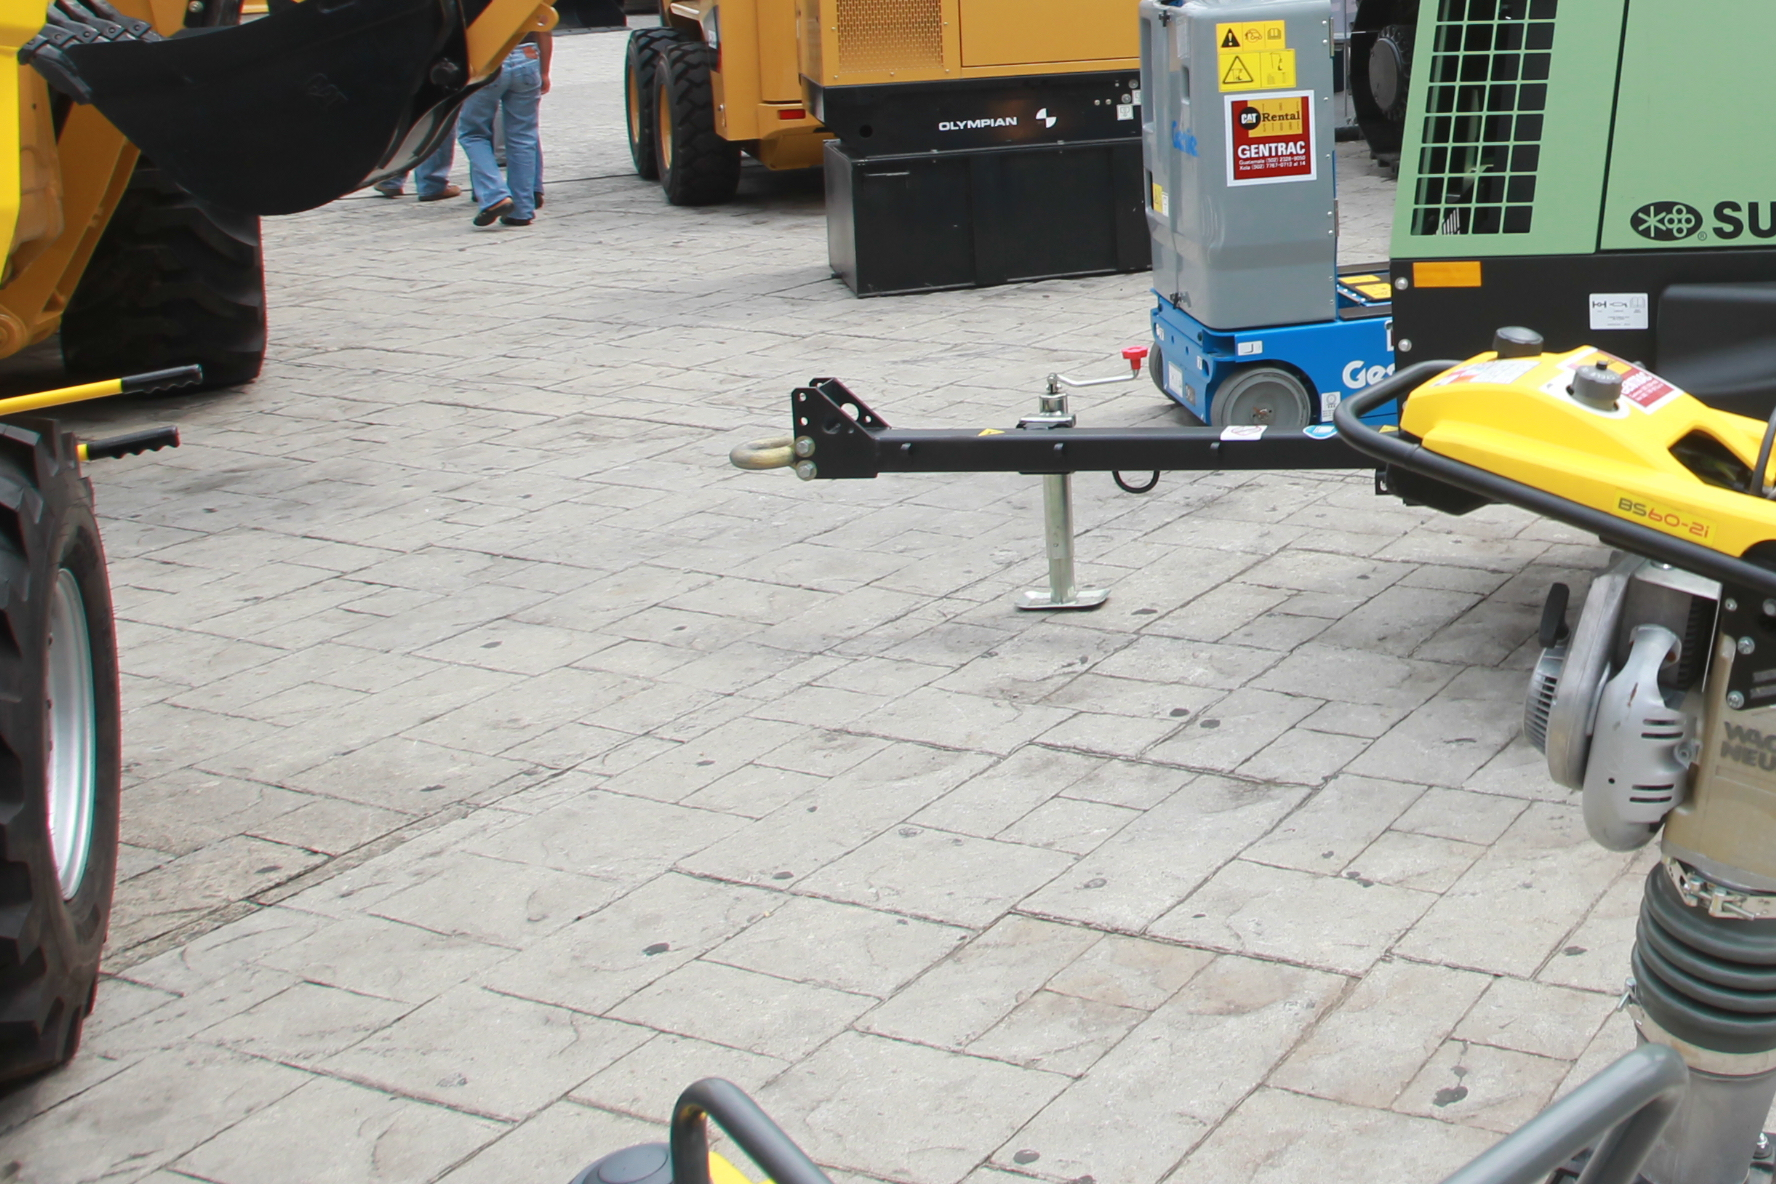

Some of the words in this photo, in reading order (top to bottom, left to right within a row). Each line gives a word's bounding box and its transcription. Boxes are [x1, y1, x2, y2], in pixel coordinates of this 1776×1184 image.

[938, 116, 1018, 132] OLYMPIAN
[1240, 113, 1259, 124] CAT
[1261, 110, 1301, 123] Rental
[1237, 140, 1306, 159] GENTRAC
[1618, 497, 1710, 539] BS60-2i
